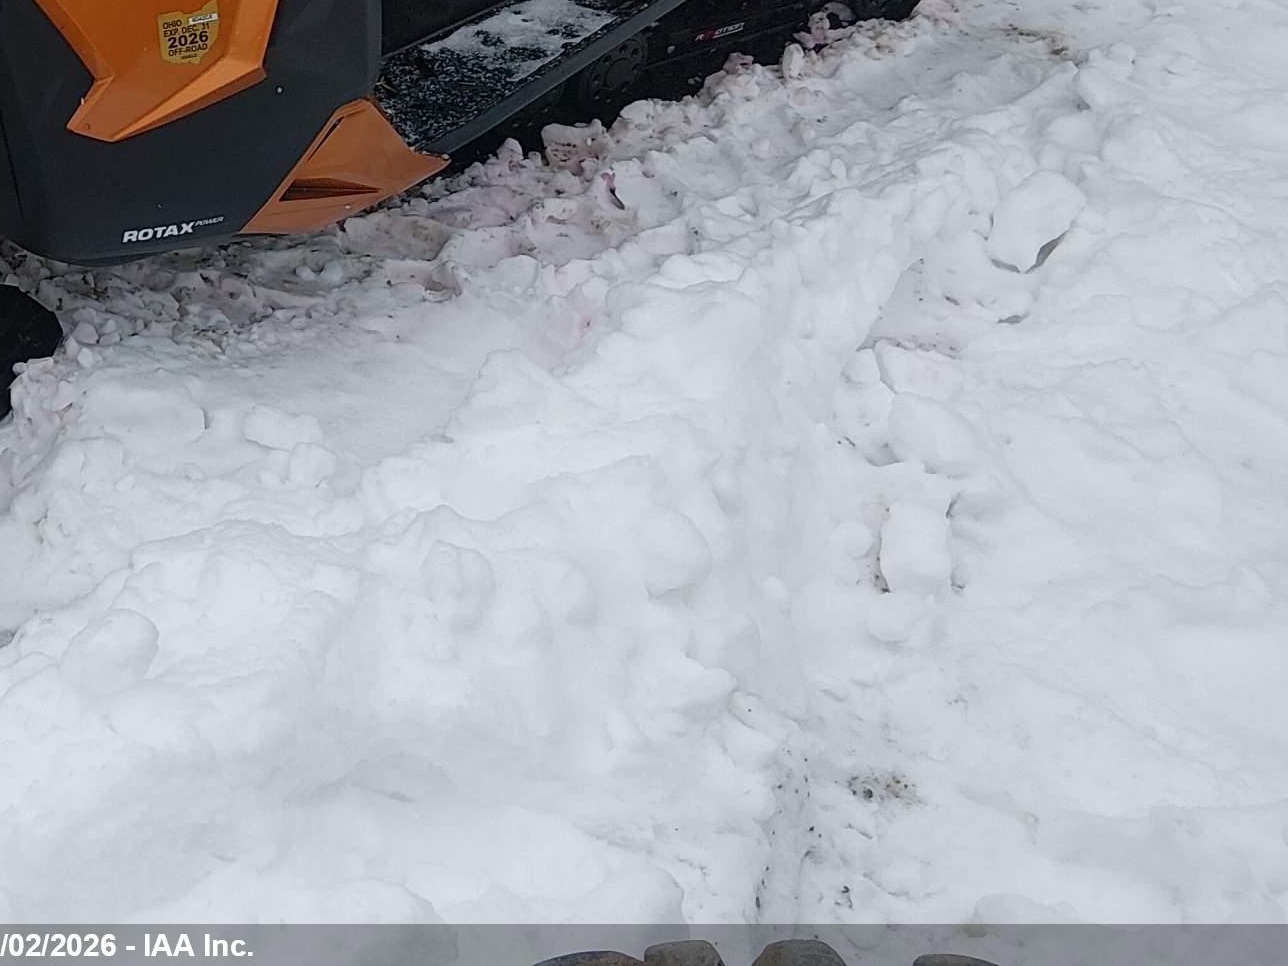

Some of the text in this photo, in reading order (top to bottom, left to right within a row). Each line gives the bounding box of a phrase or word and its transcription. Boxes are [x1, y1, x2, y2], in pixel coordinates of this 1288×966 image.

[162, 19, 182, 30] OHIO
[167, 30, 209, 49] 2026
[168, 42, 208, 57] OFF-ROAD
[122, 221, 195, 243] ROTAX
